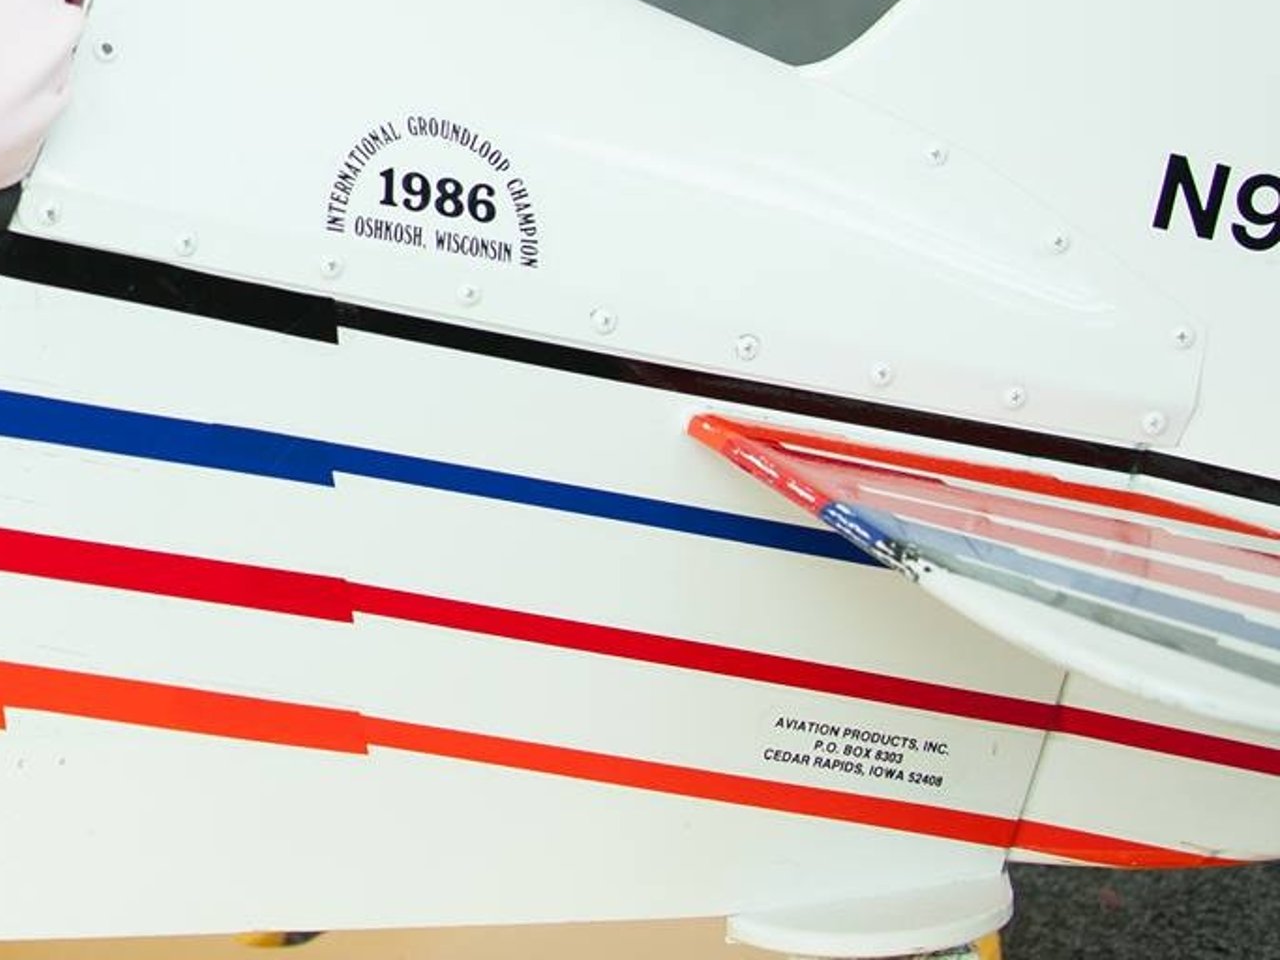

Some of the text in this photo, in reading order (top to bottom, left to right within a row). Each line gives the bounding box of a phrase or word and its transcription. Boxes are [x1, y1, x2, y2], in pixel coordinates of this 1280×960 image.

[326, 116, 538, 269] INTERNATIONAL GROUNDLOOP CHAMPION
[379, 167, 496, 223] 1986
[435, 229, 512, 263] WISCONSIN
[775, 717, 840, 737] AVIATION
[842, 727, 919, 751] PRODUCTS,
[763, 748, 810, 766] CEDAR
[812, 757, 865, 776] RAPIDS,
[869, 765, 904, 781] IOWA
[814, 740, 904, 764] P.O. BOX 8303
